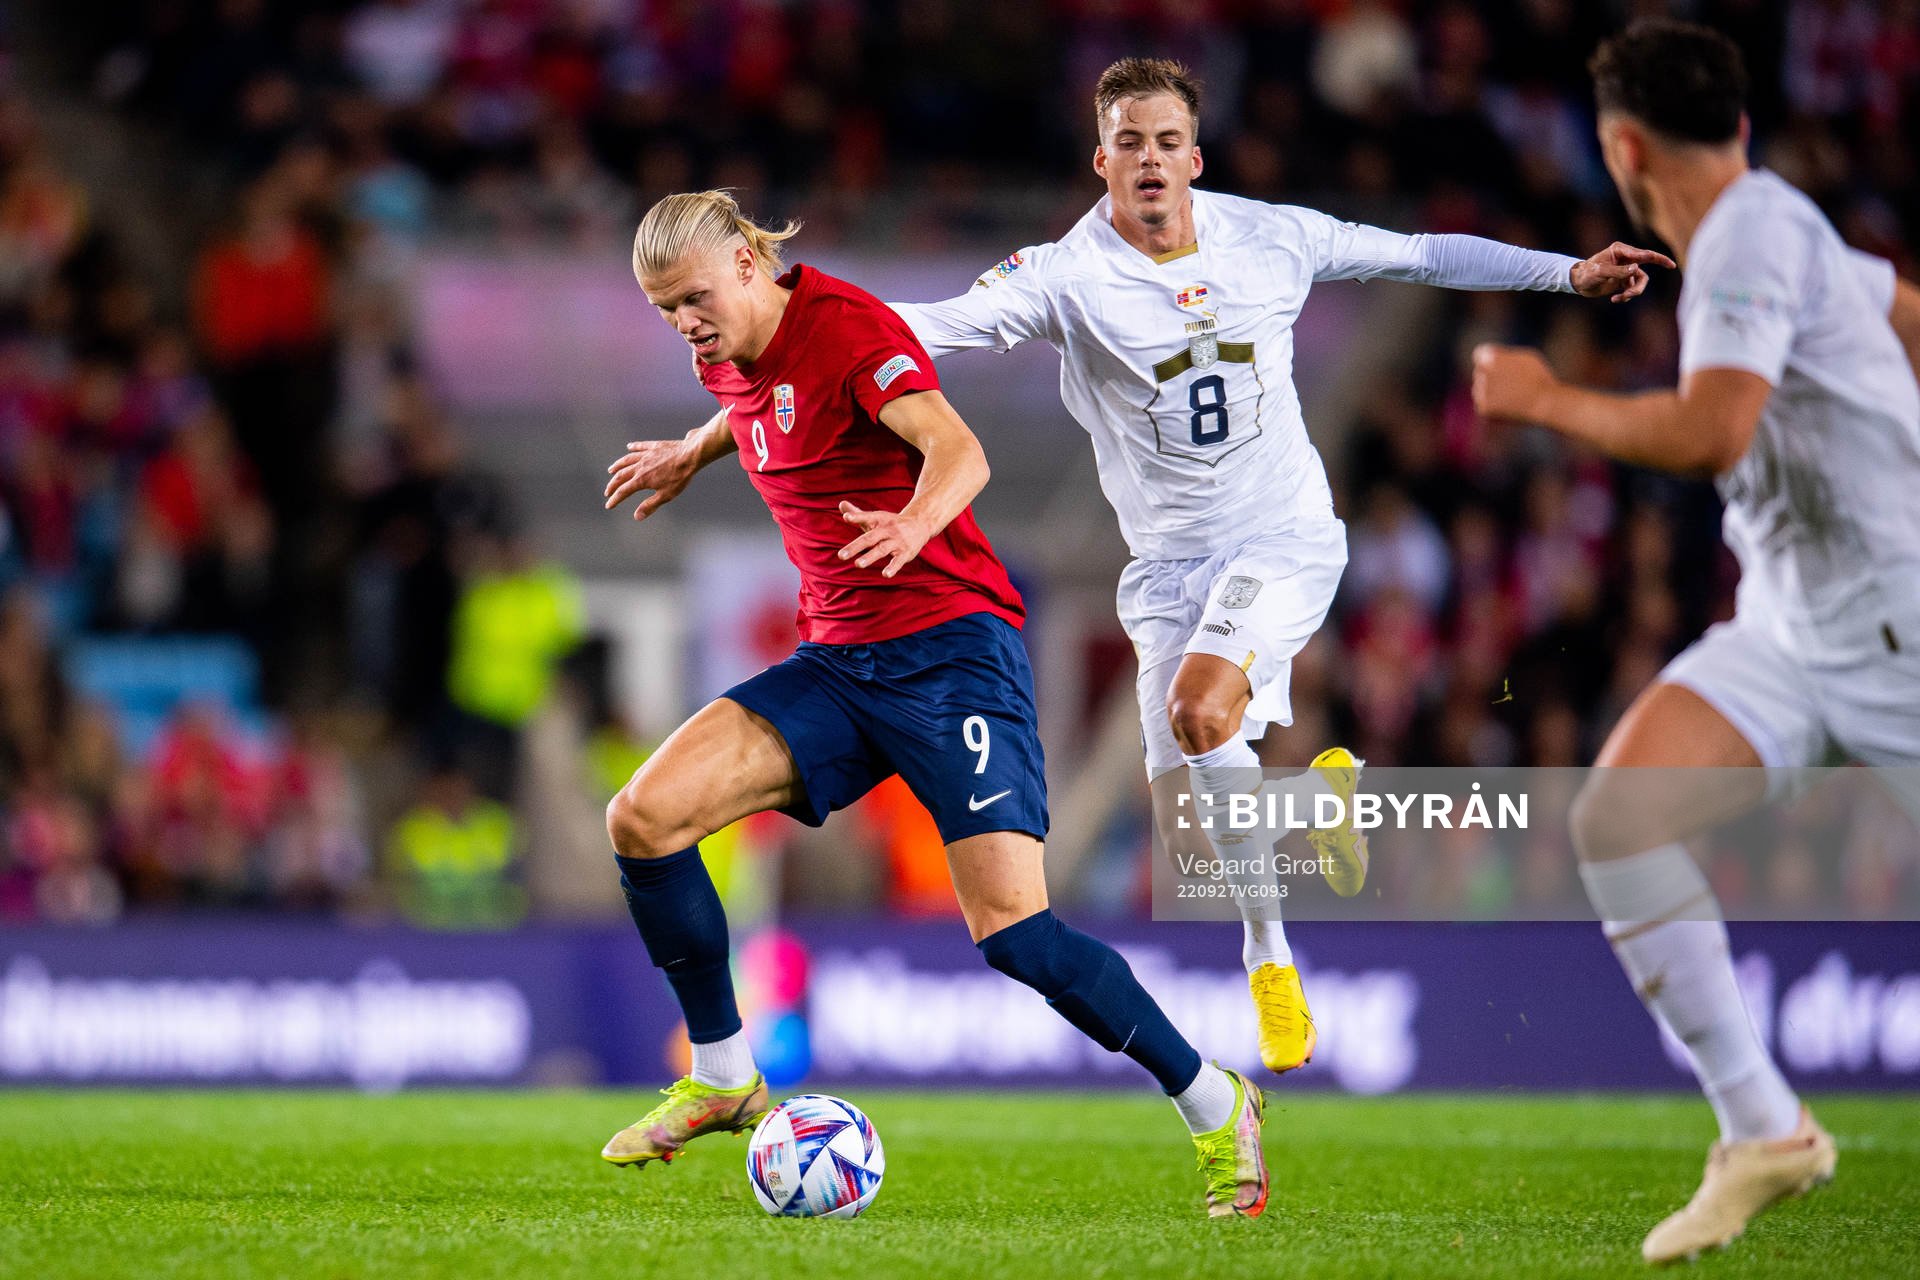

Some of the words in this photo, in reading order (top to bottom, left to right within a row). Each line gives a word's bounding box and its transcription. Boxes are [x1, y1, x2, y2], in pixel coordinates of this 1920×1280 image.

[1184, 318, 1215, 333] PUMA
[876, 359, 915, 384] FOUNDA
[1189, 374, 1230, 446] 8
[751, 419, 768, 472] 9
[1202, 623, 1231, 637] PUMA
[962, 715, 990, 774] 9
